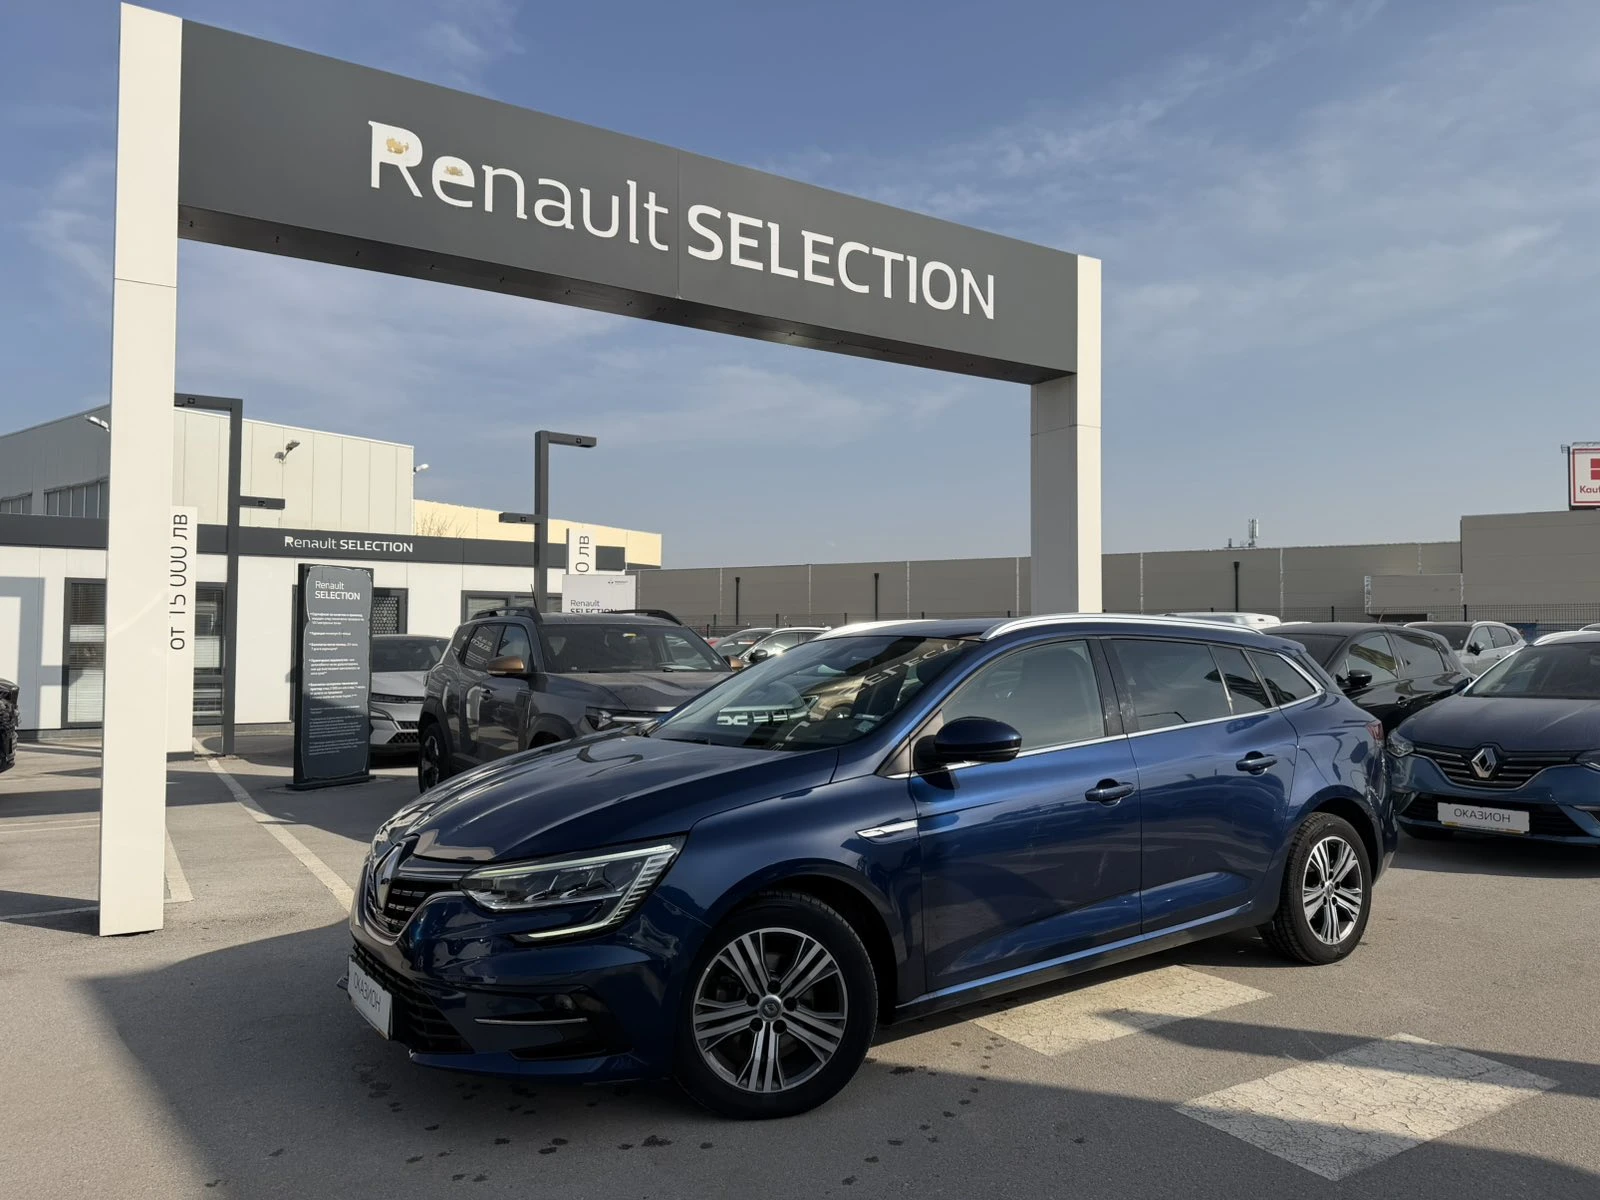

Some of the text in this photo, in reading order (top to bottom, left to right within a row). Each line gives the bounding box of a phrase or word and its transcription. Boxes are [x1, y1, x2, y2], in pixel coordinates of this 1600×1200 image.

[368, 120, 994, 319] Renault SELECTION
[284, 535, 413, 552] Renault SELECTION
[315, 580, 345, 590] Renault
[314, 590, 361, 600] SELECTION
[570, 599, 601, 607] Renault
[1453, 808, 1511, 823] ОКАЗИОН
